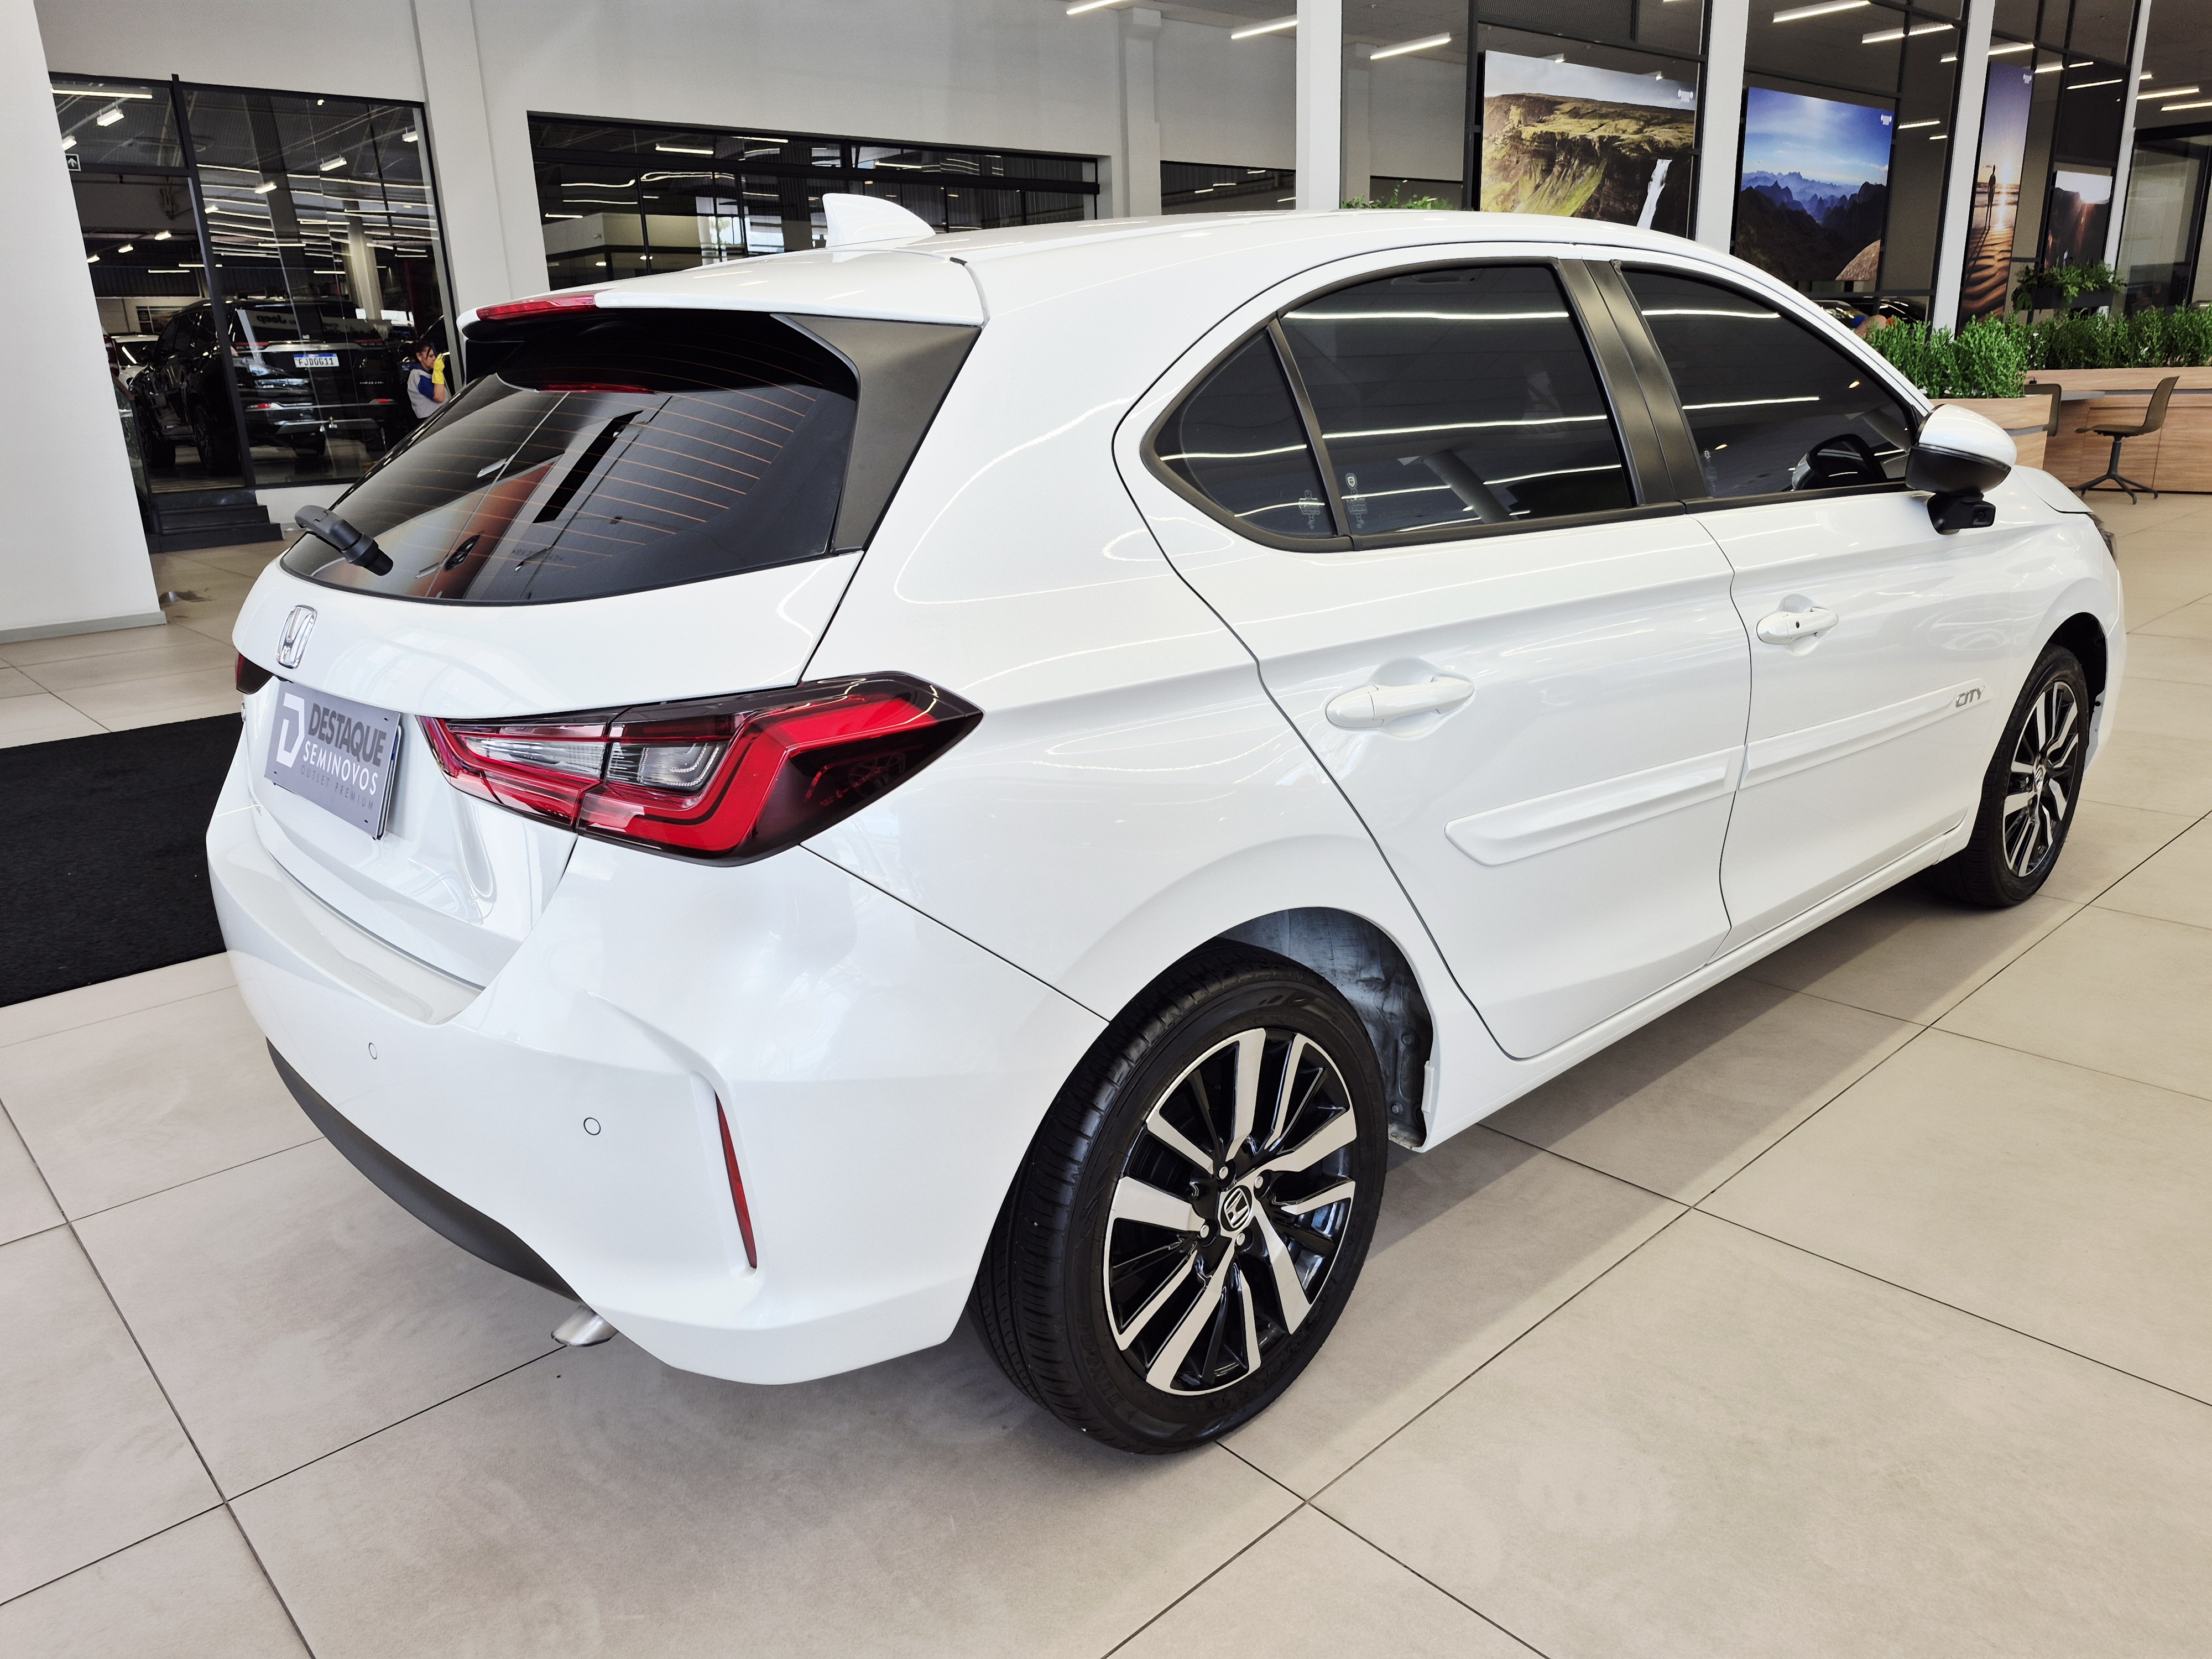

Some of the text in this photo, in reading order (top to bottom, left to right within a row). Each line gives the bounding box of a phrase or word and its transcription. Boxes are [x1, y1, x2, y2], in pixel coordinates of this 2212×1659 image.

[1956, 686, 1985, 708] CITY
[308, 703, 387, 767] DESTAQUE
[300, 765, 373, 810] OUTLET PREMIUM
[303, 740, 378, 795] SEMINOVOS
